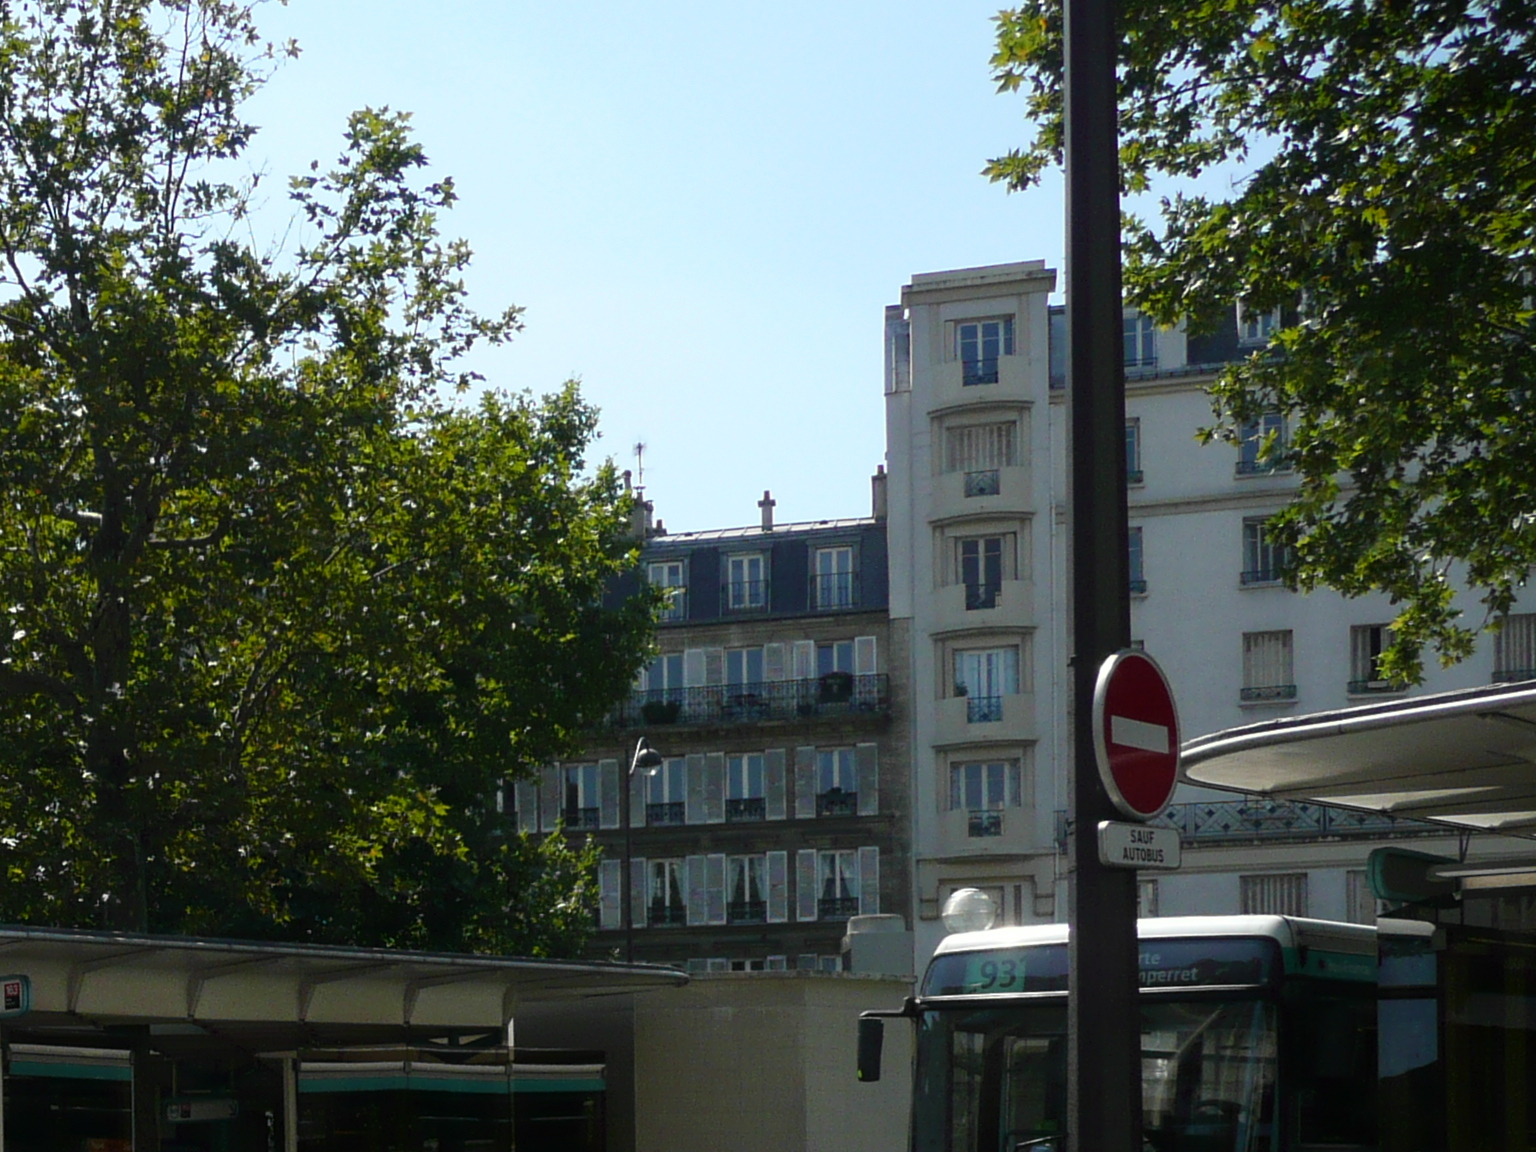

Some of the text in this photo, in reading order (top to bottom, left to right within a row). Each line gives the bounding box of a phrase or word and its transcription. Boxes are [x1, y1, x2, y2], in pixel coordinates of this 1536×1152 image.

[1130, 829, 1155, 845] SAUF
[1122, 847, 1165, 863] AUTOBUS
[1138, 952, 1161, 965] rte
[980, 959, 1017, 989] 93
[1138, 967, 1199, 986] perret
